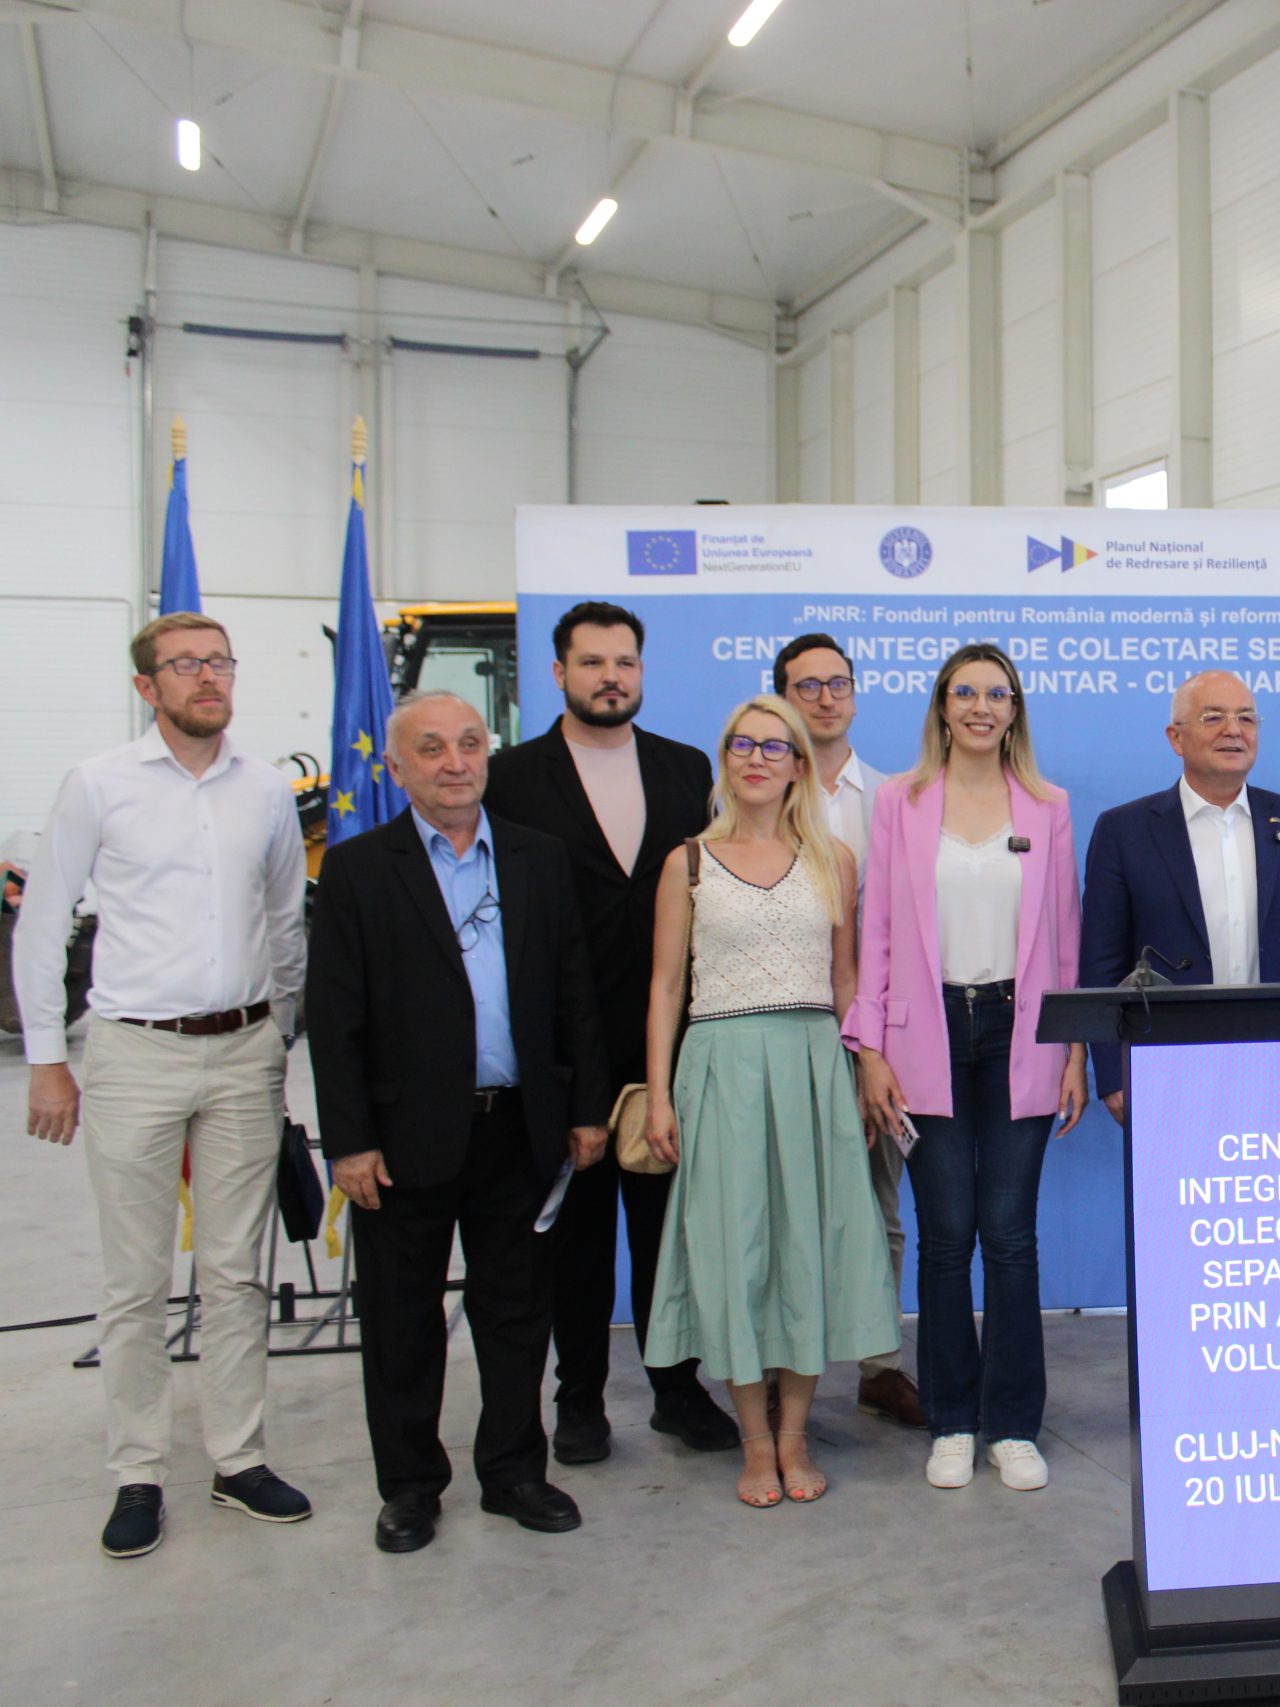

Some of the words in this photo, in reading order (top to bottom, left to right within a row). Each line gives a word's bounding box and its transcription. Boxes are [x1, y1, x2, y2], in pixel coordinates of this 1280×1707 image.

[751, 534, 765, 544] de
[1106, 541, 1146, 552] Planul
[1150, 541, 1203, 554] Național
[702, 548, 749, 558] Uniunea
[752, 547, 812, 559] Europeană
[703, 561, 802, 572] NextGenerationEU
[1106, 558, 1122, 569] de
[1126, 558, 1190, 569] Redresare
[1193, 558, 1203, 571] și
[1206, 558, 1268, 571] Reziliență
[873, 607, 948, 623] Fonduri
[953, 609, 1016, 626] pentru
[1022, 607, 1105, 624] România
[1111, 608, 1194, 624] modernă
[1199, 607, 1216, 628] și
[1008, 637, 1048, 661] DE
[1058, 636, 1239, 662] COLECTARE
[1020, 670, 1119, 694] UNTAR
[1190, 1301, 1266, 1332] PRIN
[1184, 1476, 1225, 1507] 20
